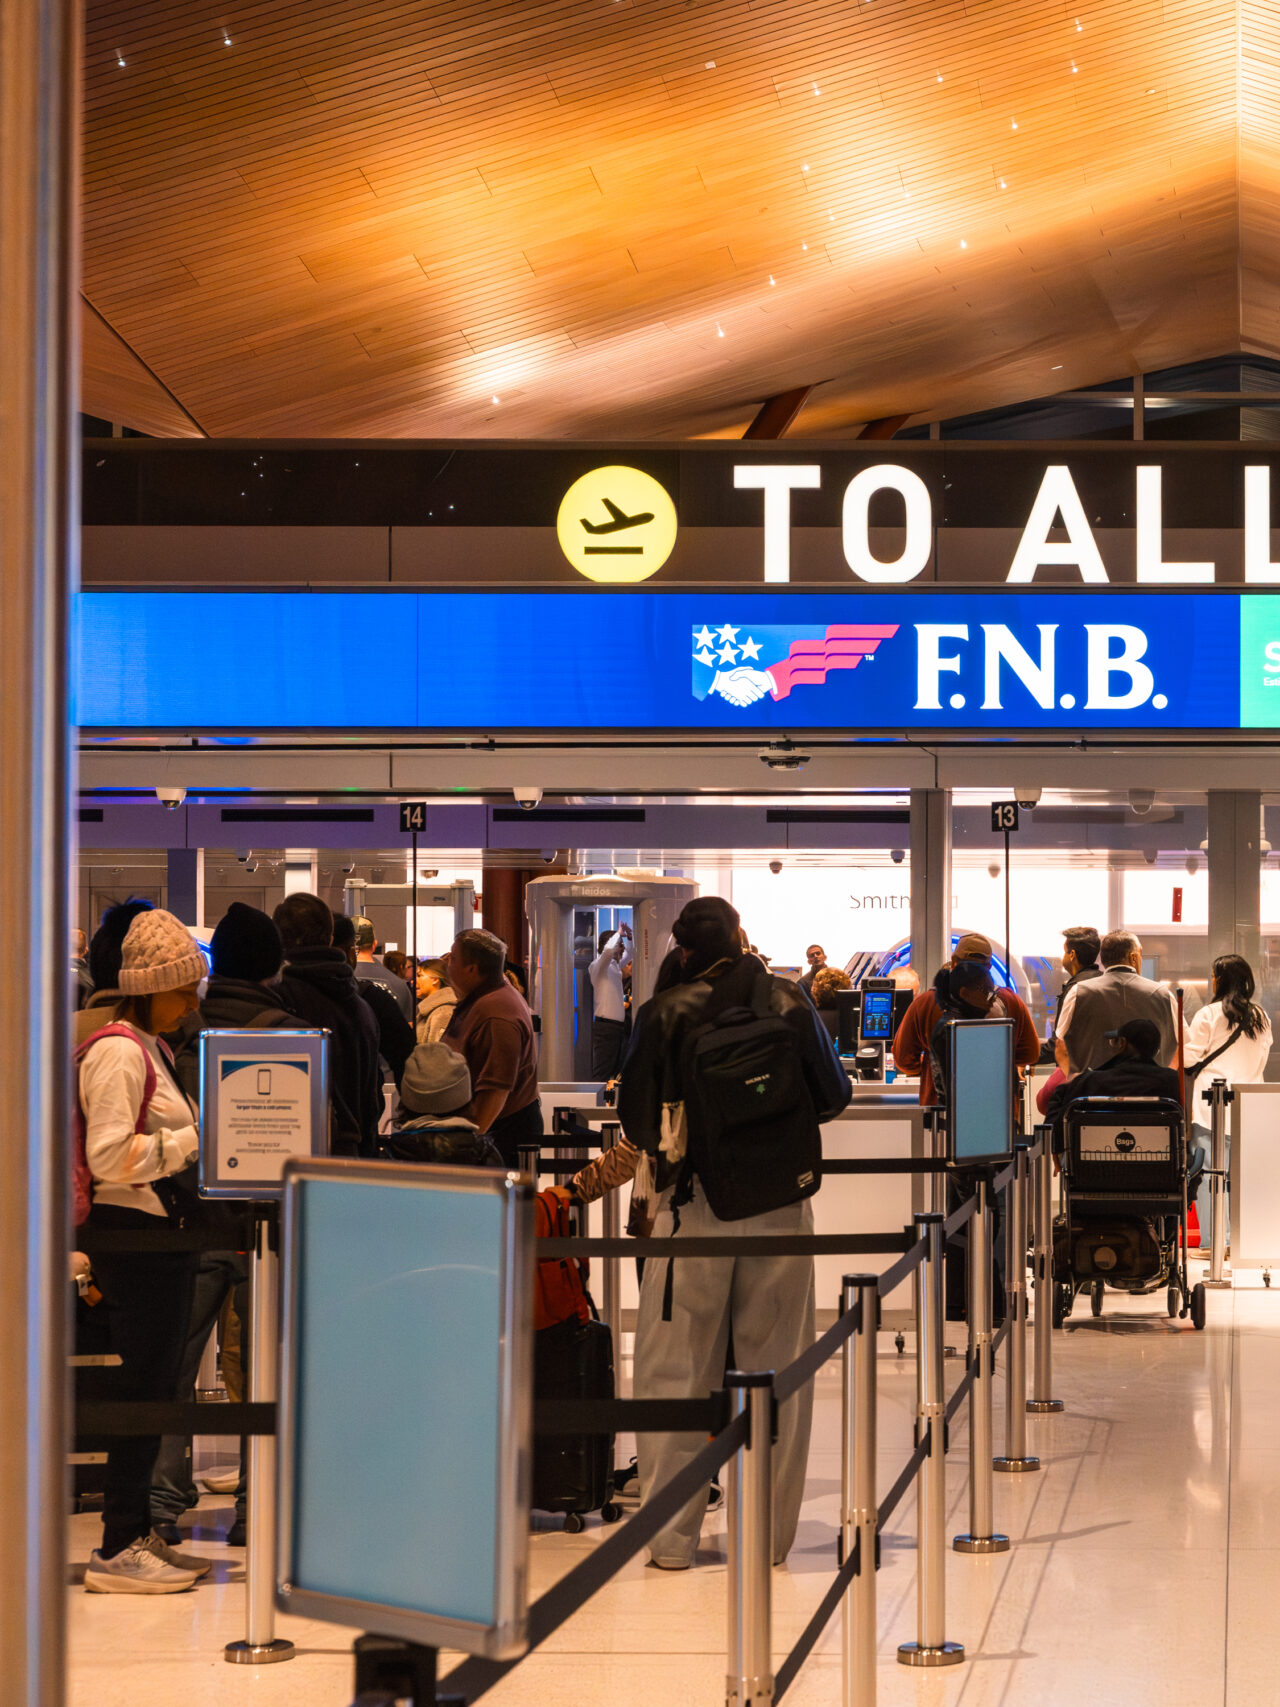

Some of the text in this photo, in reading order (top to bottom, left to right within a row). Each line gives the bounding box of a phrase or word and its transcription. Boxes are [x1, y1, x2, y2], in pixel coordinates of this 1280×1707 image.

[733, 464, 932, 583] TO
[912, 623, 1169, 711] F.N.B.
[403, 806, 424, 828] 14
[994, 805, 1015, 827] 13
